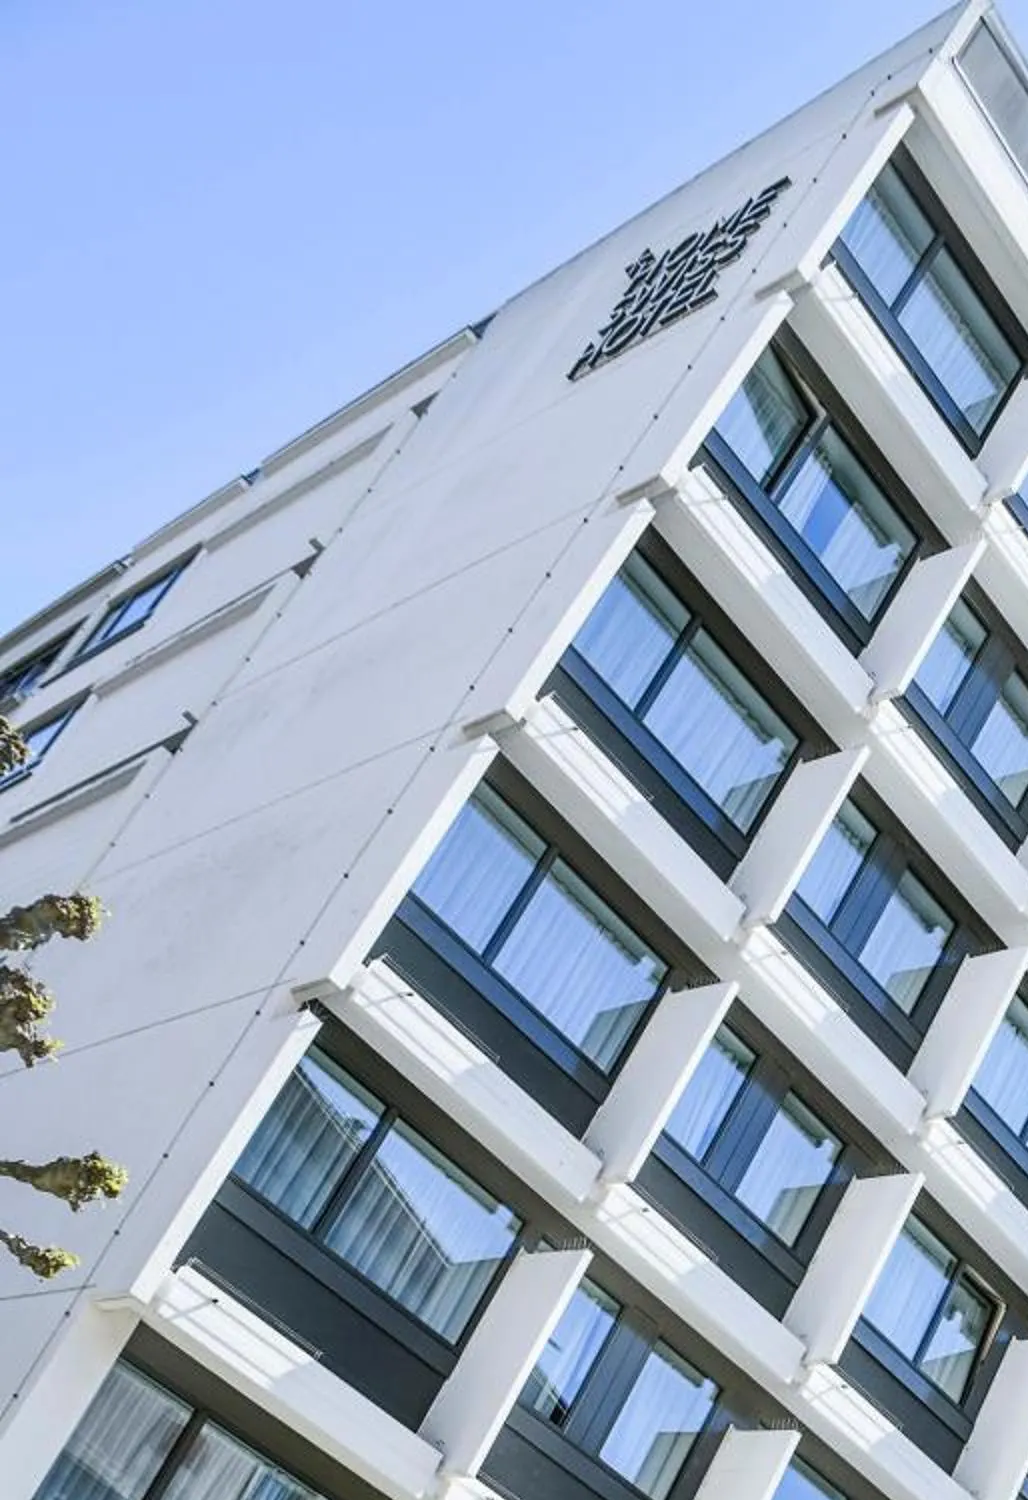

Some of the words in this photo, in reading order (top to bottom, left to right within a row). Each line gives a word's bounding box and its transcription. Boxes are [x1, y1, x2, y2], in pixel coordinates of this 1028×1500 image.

[599, 221, 761, 335] SWISS
[624, 176, 792, 297] HOME
[566, 269, 719, 381] HOTEL
